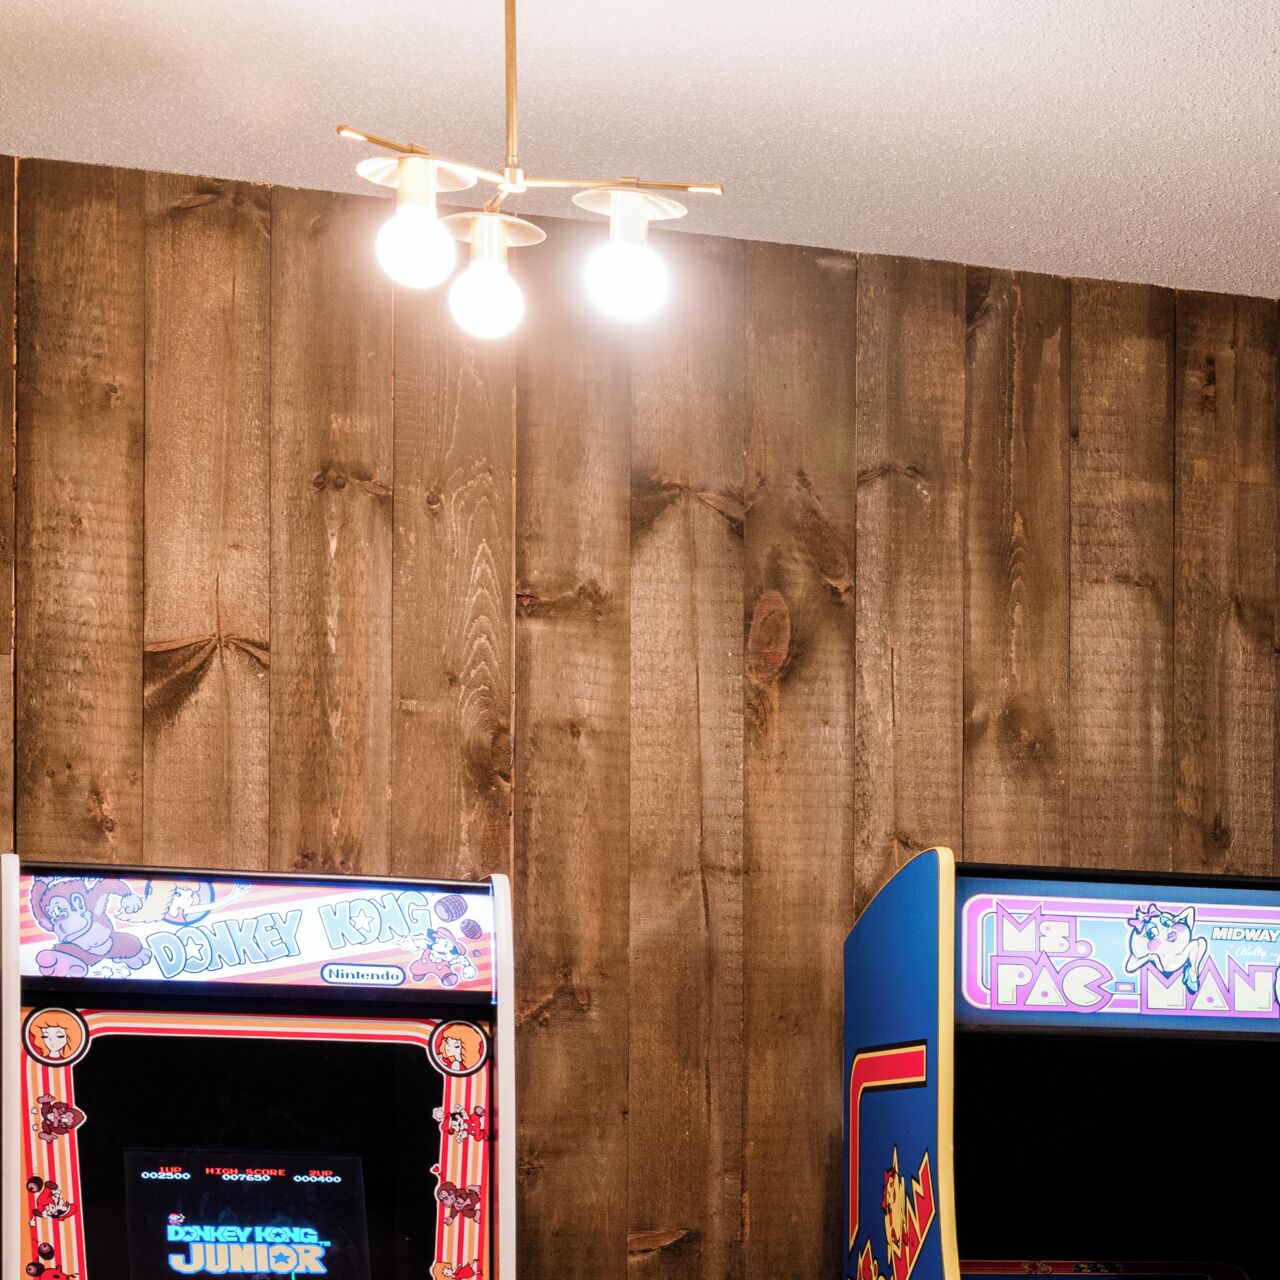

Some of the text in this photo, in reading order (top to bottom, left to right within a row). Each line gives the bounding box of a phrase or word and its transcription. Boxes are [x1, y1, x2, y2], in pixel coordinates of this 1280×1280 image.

[147, 890, 432, 979] DONKEY KONG
[328, 968, 400, 982] Nintendo
[992, 955, 1277, 1016] PAC-MAN
[141, 1171, 341, 1183] 002500 007650 000400
[205, 1167, 238, 1175] HIGH
[246, 1168, 286, 1176] SCORE
[167, 1225, 252, 1242] DONKEY
[255, 1226, 318, 1243] KONG
[168, 1243, 327, 1274] JUNIOR
